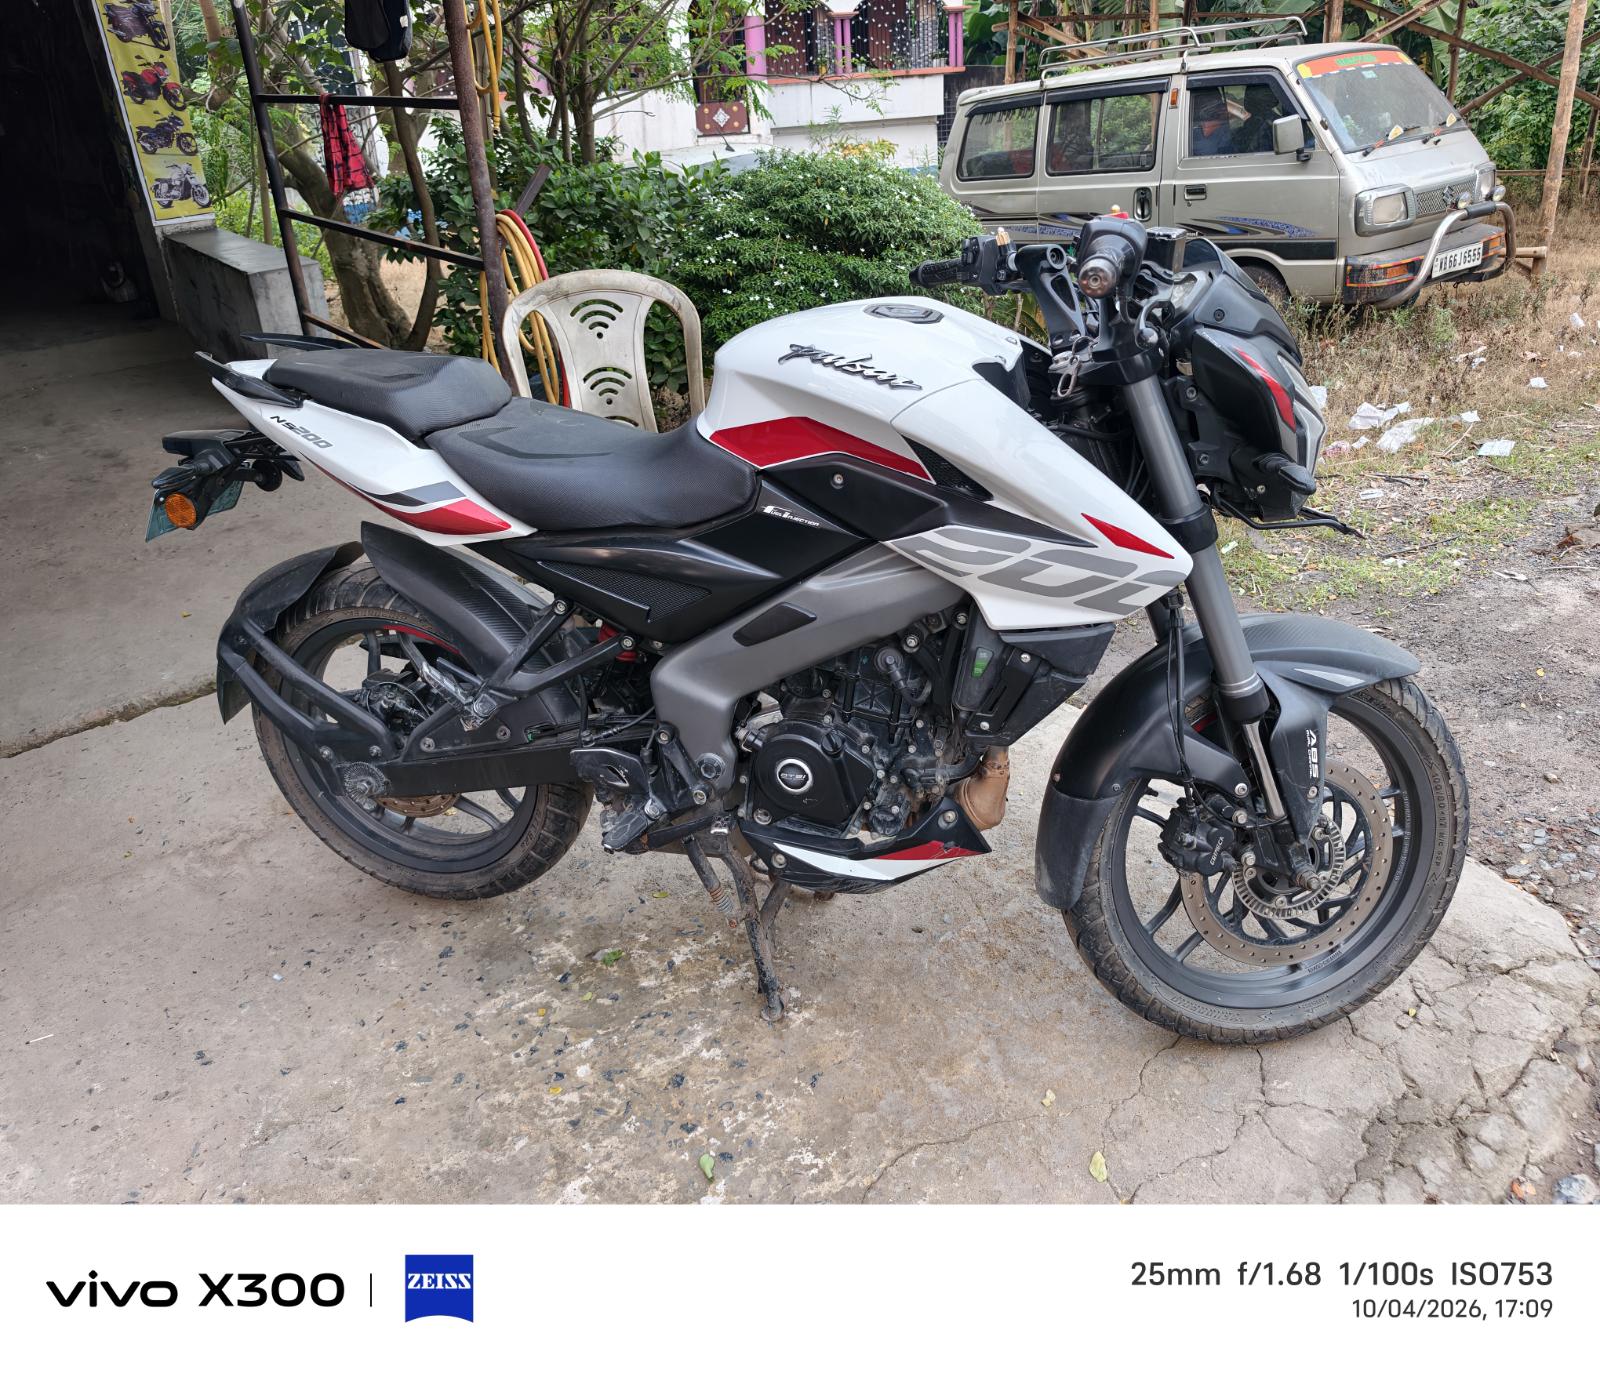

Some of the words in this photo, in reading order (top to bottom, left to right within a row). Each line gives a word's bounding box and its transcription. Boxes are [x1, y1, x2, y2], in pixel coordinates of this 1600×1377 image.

[1439, 247, 1482, 272] WB66J6555
[270, 415, 334, 449] NS200
[1309, 729, 1319, 778] ABS
